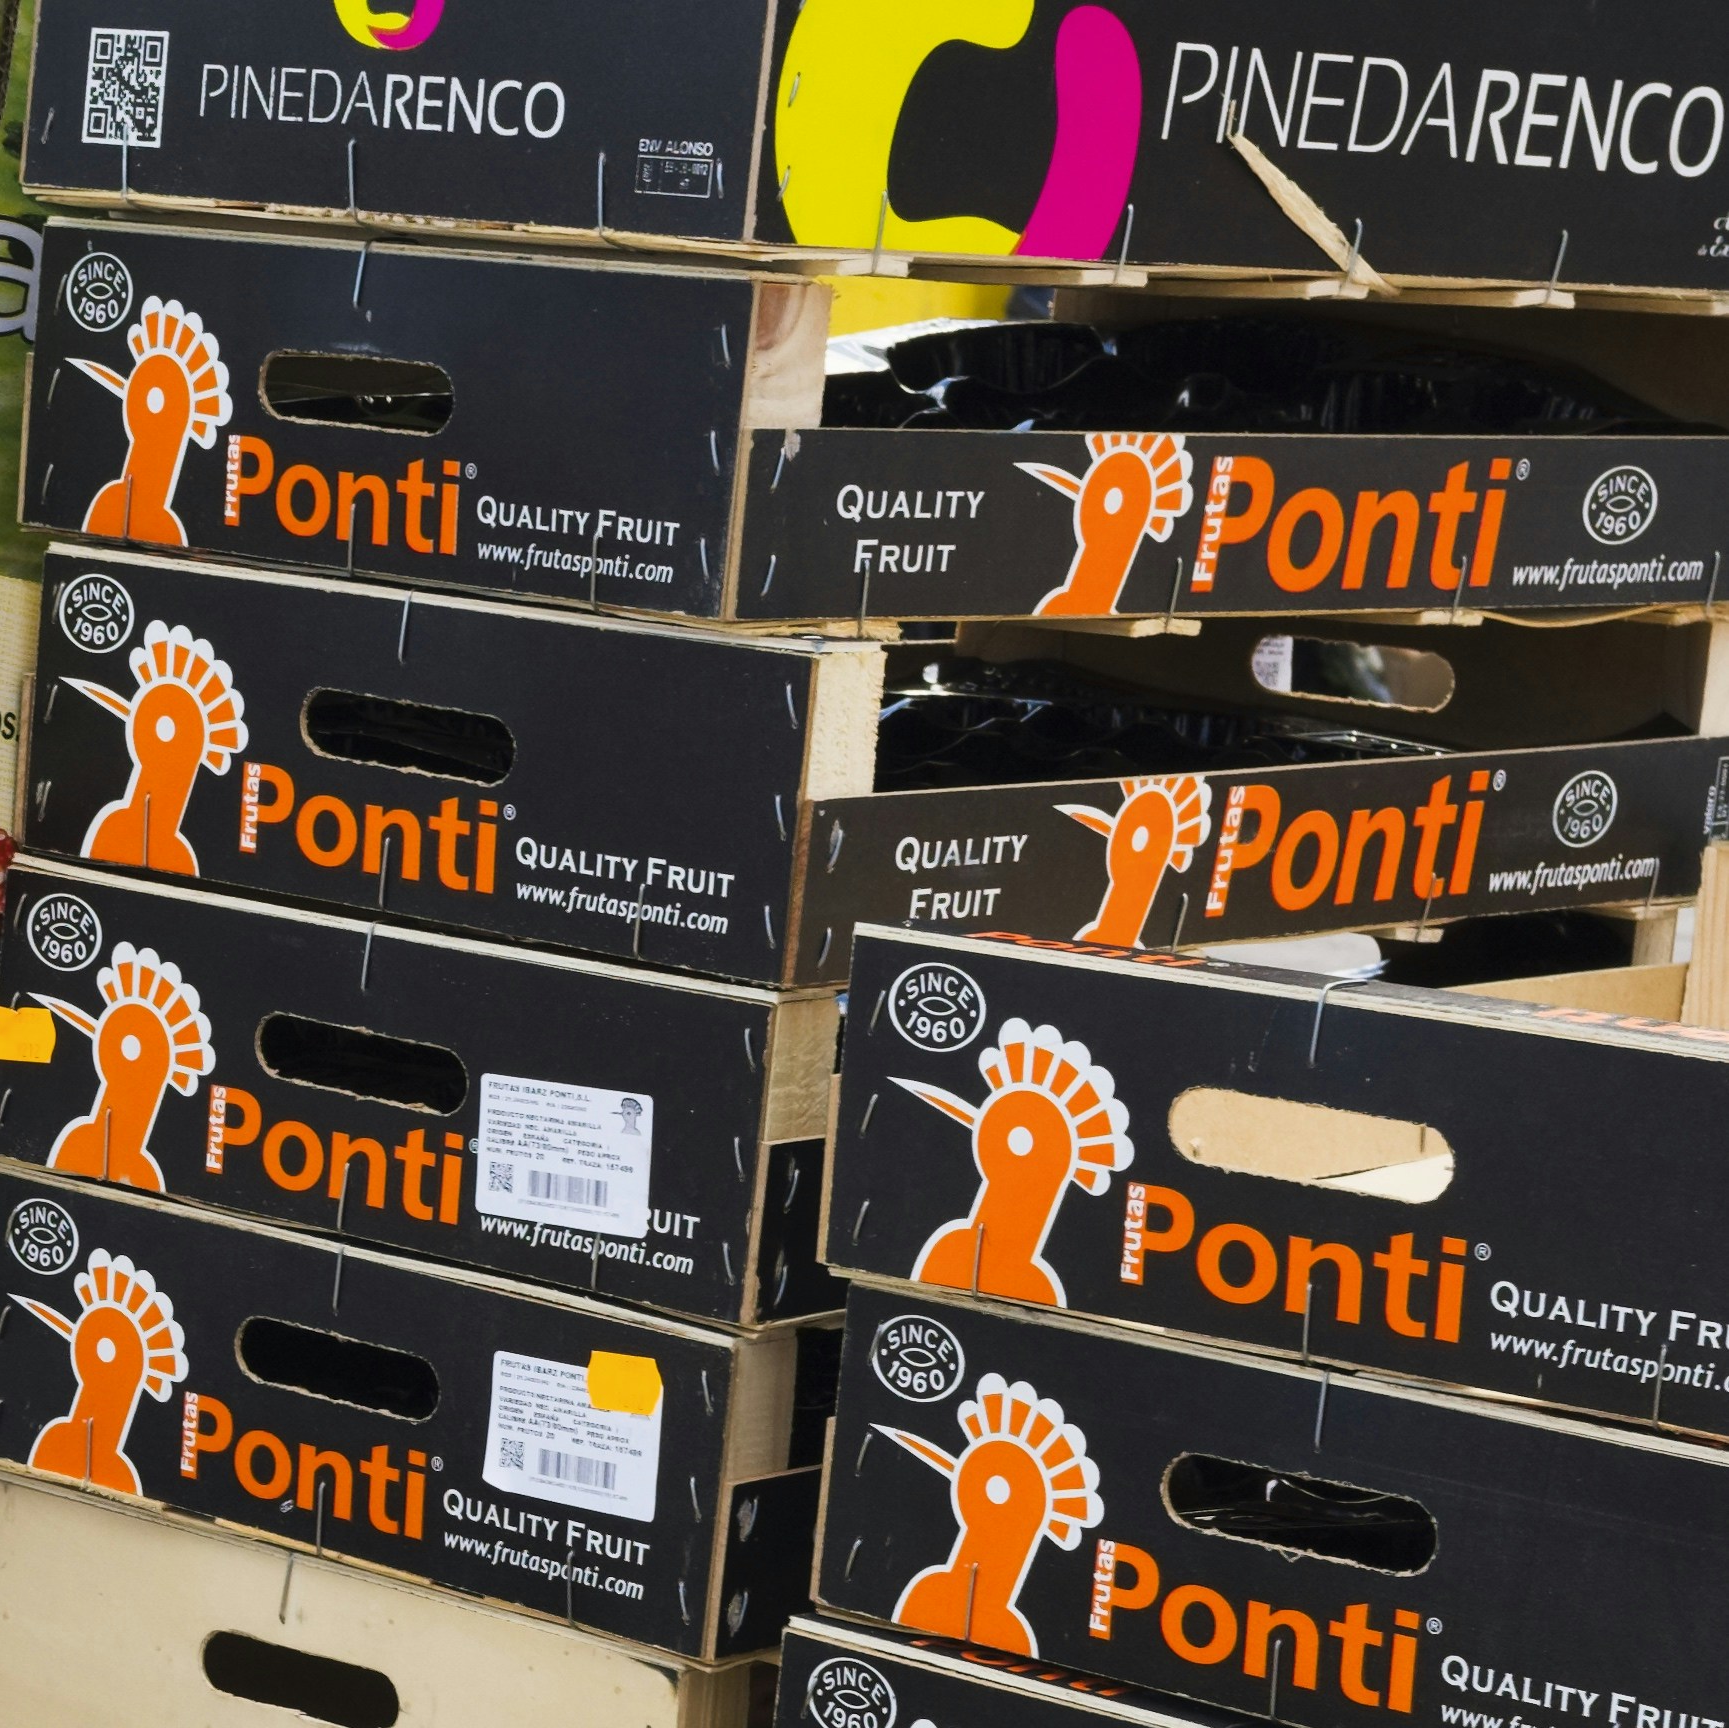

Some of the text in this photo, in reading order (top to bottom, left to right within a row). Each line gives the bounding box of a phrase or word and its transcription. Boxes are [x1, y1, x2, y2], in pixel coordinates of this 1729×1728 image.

[199, 64, 564, 139] PINEDARENCO
[1161, 40, 1725, 179] PINEDARENCO
[666, 141, 713, 157] ALONSO
[75, 259, 123, 289] SINCE
[77, 297, 119, 325] 1960
[224, 431, 241, 526] Frutas
[234, 436, 460, 555] Ponti
[1596, 477, 1646, 505] SINCE
[477, 495, 680, 548] QUALITY FRUIT
[836, 484, 985, 524] QUALITY
[1191, 455, 1233, 592] Frutas
[1214, 456, 1512, 592] Ponti
[1594, 509, 1643, 540] 1960
[477, 539, 674, 584] www.frutasponti.com
[854, 540, 956, 574] FRUIT
[1513, 557, 1704, 589] www.frutasponti.com
[71, 582, 124, 616] SINCE
[73, 613, 121, 646] 1960
[239, 762, 260, 853] Frutas
[1559, 780, 1613, 810] SINCE
[254, 762, 499, 895] Ponti
[1222, 769, 1490, 915] Ponti
[1559, 811, 1604, 844] 1960
[515, 836, 734, 900] QUALITY FRUIT
[894, 834, 1027, 873] QUALITY
[1205, 786, 1246, 919] Frutas
[1488, 858, 1656, 895] www.frutasponti.com
[38, 903, 93, 938] SINCE
[516, 880, 729, 935] www.frutasponti.com
[909, 888, 1000, 921] FRUIT
[40, 933, 89, 965] 1960
[902, 970, 976, 1006] SINCE
[902, 1008, 967, 1045] 1960
[488, 1081, 520, 1093] FRUTAS
[206, 1084, 227, 1174] Frutas
[220, 1085, 464, 1226] Ponti
[14, 1206, 71, 1236] SINCE
[1120, 1182, 1145, 1283] Frutas
[17, 1236, 66, 1267] 1960
[480, 1213, 694, 1275] www.frutasponti.com
[1137, 1183, 1466, 1344] Ponti
[1490, 1281, 1657, 1337] QUALITY
[886, 1323, 951, 1362] SINCE
[500, 1359, 531, 1371] FRUTAS
[886, 1361, 946, 1395] 1960
[192, 1392, 429, 1540] Ponti
[443, 1489, 650, 1568] QUALITY FRUIT
[443, 1528, 645, 1601] www.frutasponti.com
[1089, 1538, 1116, 1636] Frutas
[1106, 1540, 1422, 1715] Ponti
[821, 1665, 888, 1707] SINCE
[1440, 1653, 1605, 1719] QUALITY
